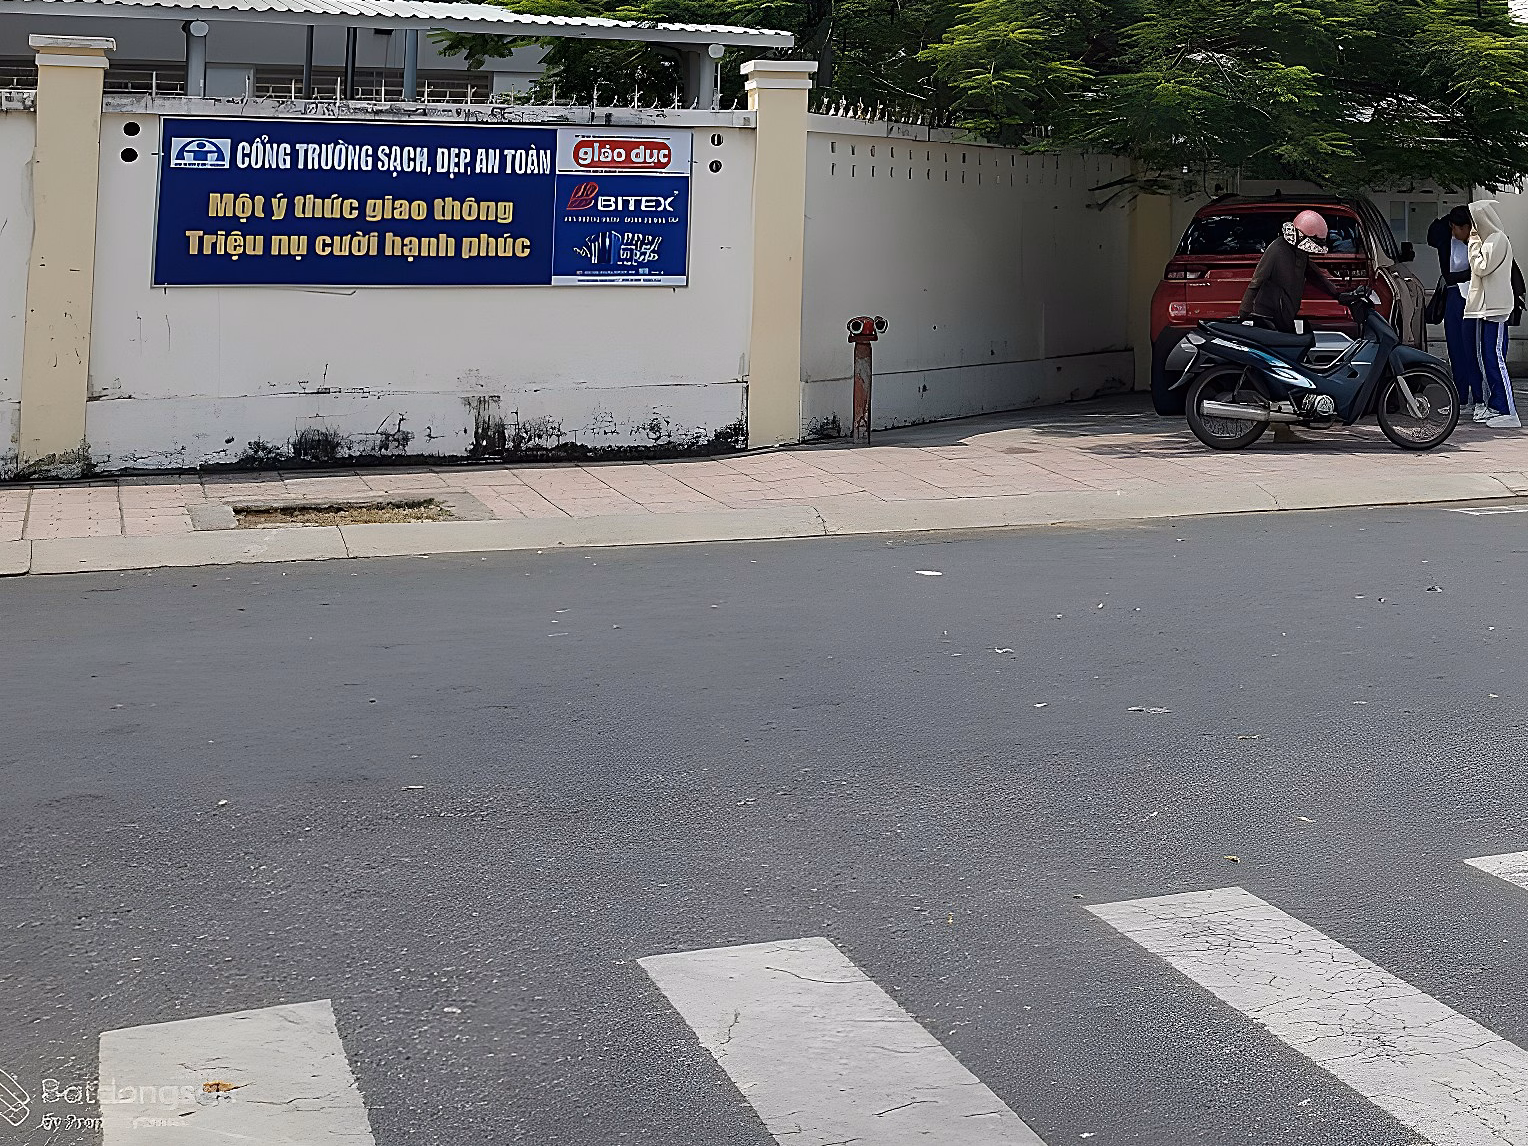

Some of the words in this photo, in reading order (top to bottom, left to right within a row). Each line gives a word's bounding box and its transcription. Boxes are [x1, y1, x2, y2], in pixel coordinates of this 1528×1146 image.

[236, 134, 291, 169] CỔNG
[295, 139, 373, 171] TRƯỜNG
[504, 144, 551, 174] TOÀN
[630, 145, 669, 166] dục
[208, 192, 265, 223] Một
[271, 192, 288, 221] ý
[294, 193, 359, 219] thức
[365, 195, 428, 222] giao
[433, 196, 514, 224] thông
[597, 195, 674, 212] BITEX
[185, 230, 265, 261] Triệu
[270, 235, 308, 261] nụ
[315, 231, 379, 256] cười
[384, 232, 455, 262] hạnh
[461, 233, 531, 259] phúc
